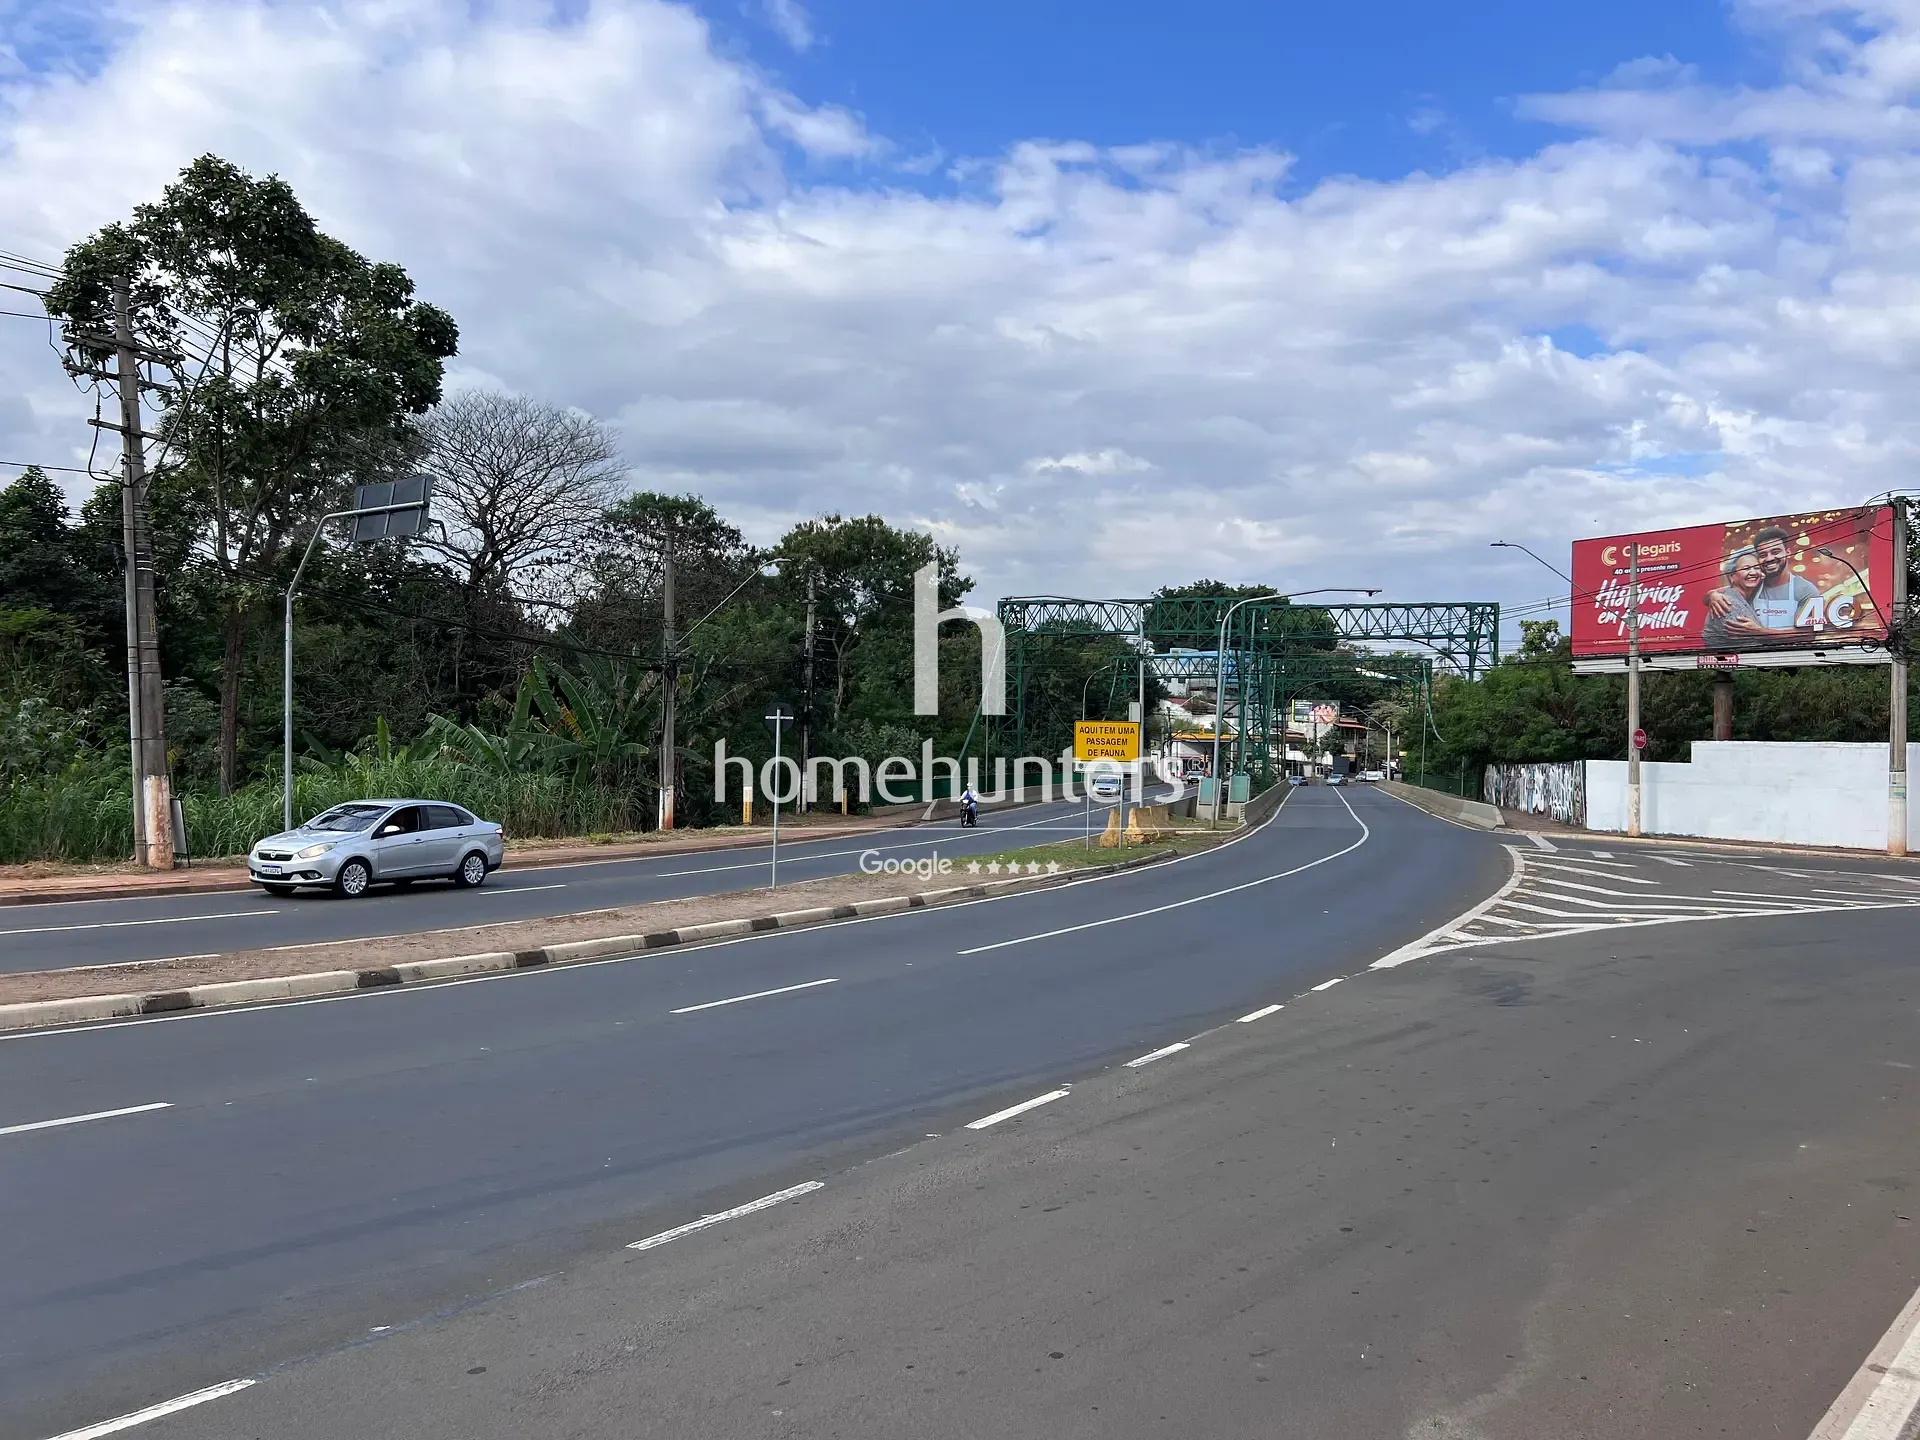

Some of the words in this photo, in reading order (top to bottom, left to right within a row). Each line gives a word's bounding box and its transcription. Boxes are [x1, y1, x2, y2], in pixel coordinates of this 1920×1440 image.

[1622, 541, 1681, 558] Clegaris
[1618, 603, 1688, 636] fmília
[1079, 726, 1098, 734] AQUI
[1099, 726, 1116, 734] TEM
[1118, 727, 1135, 735] UMA
[1086, 737, 1128, 746] PASSAGEM
[1088, 749, 1098, 757] DE
[1100, 749, 1126, 757] FAUNA
